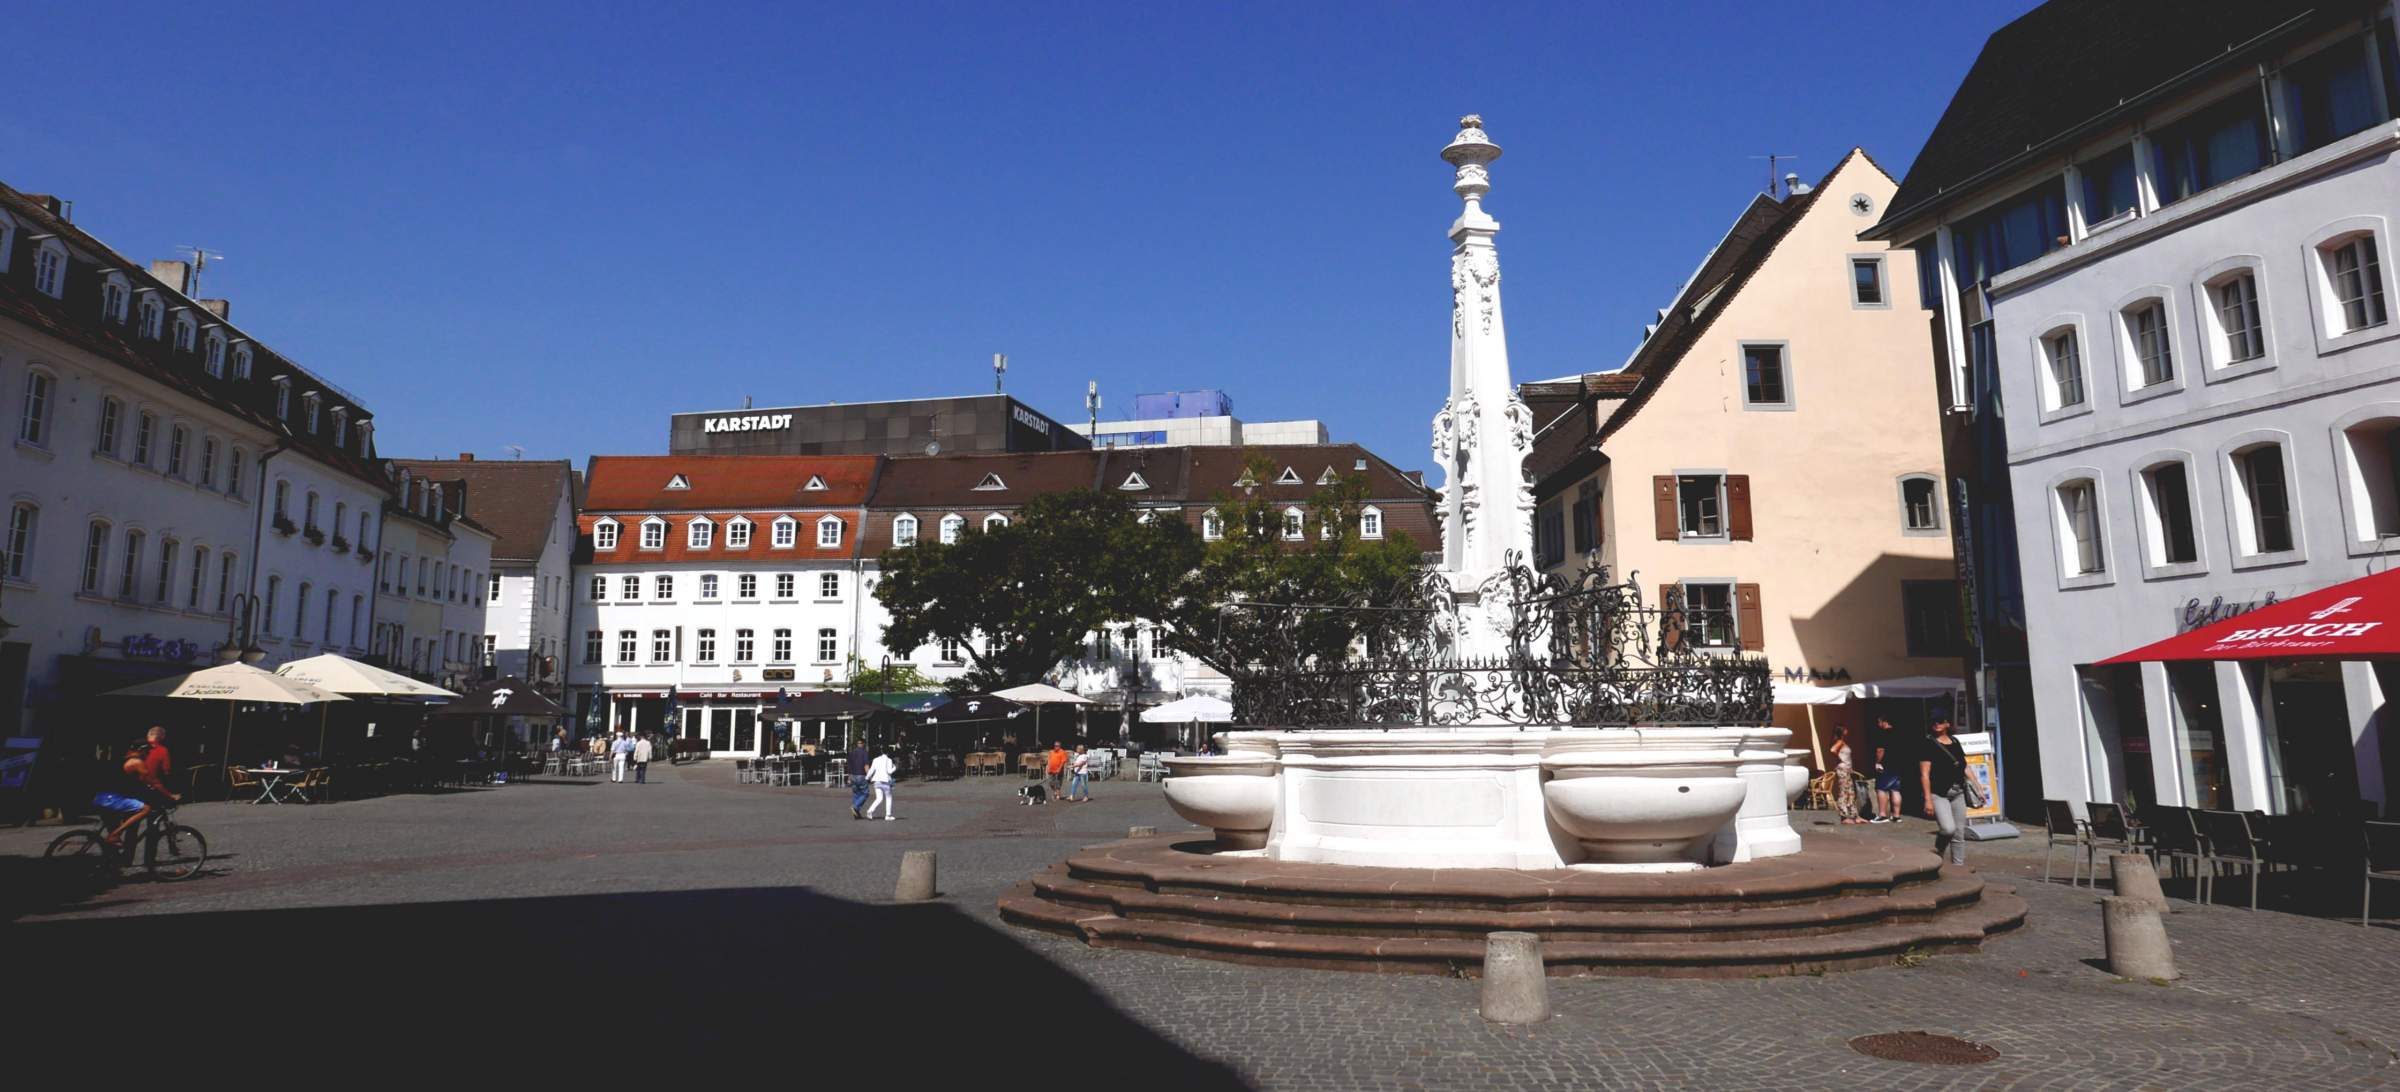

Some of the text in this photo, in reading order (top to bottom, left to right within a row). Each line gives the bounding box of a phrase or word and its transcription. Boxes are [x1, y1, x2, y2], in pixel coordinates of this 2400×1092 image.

[704, 414, 792, 433] KARSTADT
[1014, 405, 1049, 436] KARSTADT
[2216, 621, 2383, 644] BRUCH
[1784, 666, 1852, 684] MAJA
